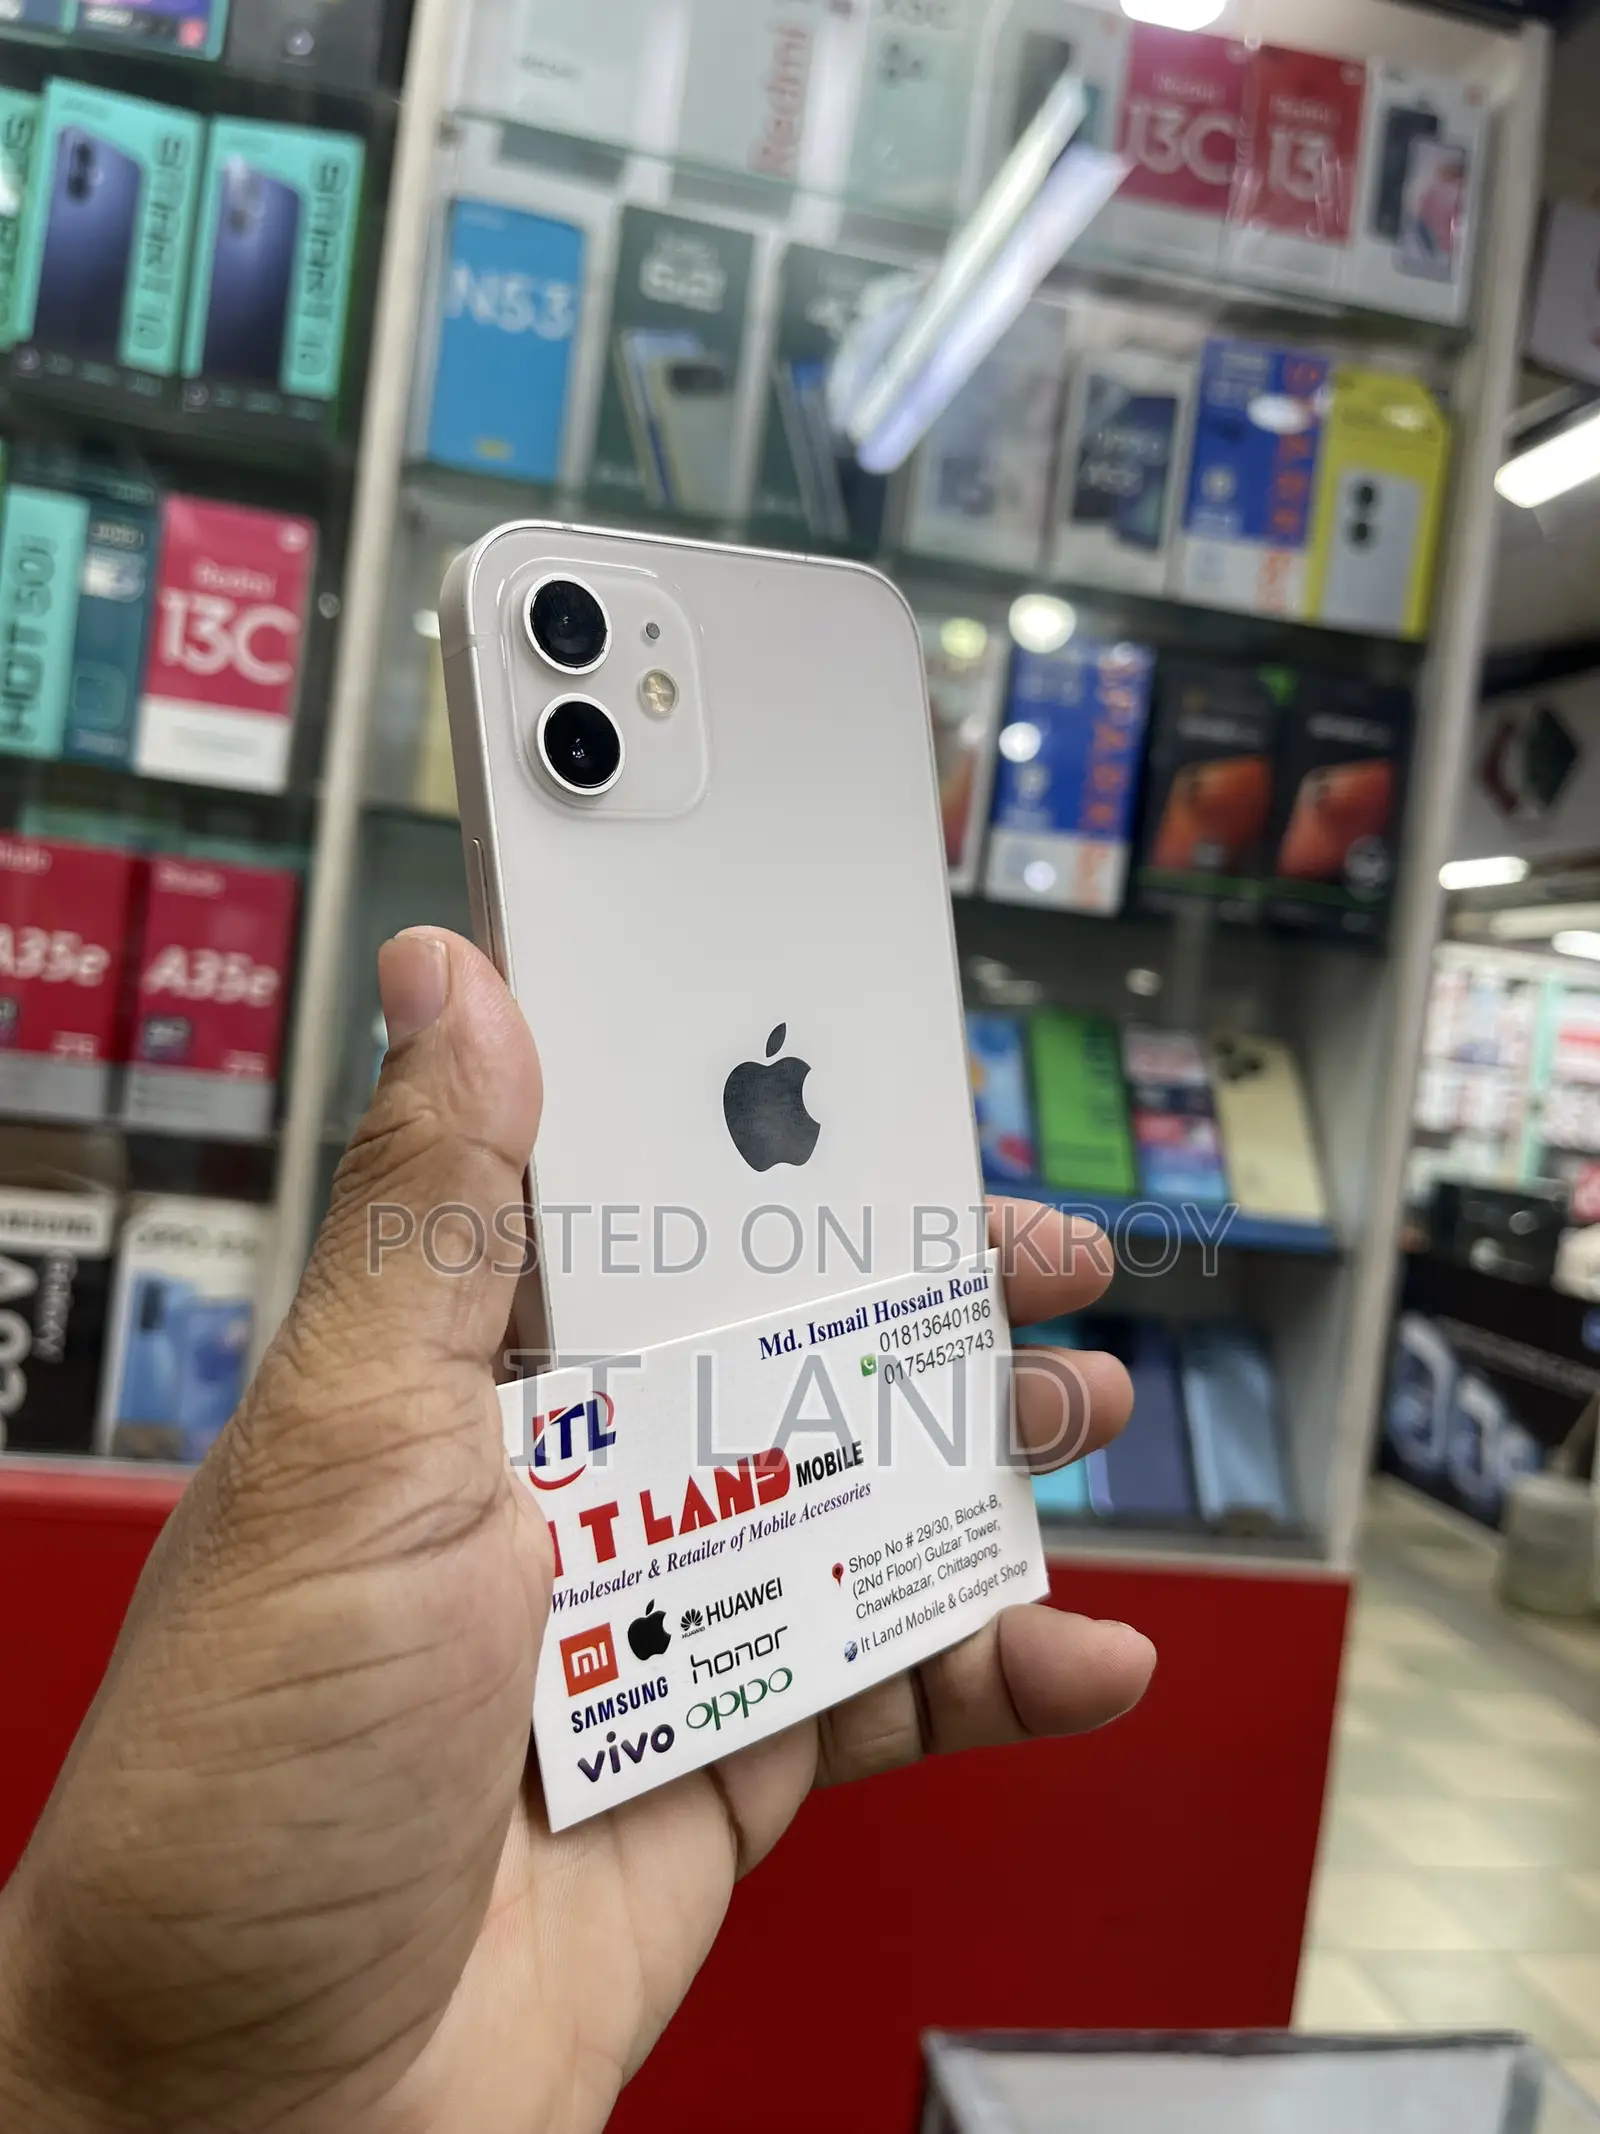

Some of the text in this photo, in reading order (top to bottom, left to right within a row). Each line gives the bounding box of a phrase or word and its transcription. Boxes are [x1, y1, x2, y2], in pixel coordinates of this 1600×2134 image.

[1126, 99, 1238, 187] 13C
[159, 587, 300, 685] 13C
[1, 620, 48, 742] HOT
[758, 1270, 990, 1360] Md. Ismail Hossain Roni
[879, 1298, 991, 1352] 01813640186
[884, 1329, 995, 1385] 01754523743
[639, 1447, 791, 1546] LAND
[795, 1440, 865, 1488] MOBILE
[551, 1482, 872, 1614] Wholesaler & Retailer of Mobile Accessories
[849, 1494, 1002, 1574] Shop No # 29/30, Block-B,
[852, 1518, 1001, 1600] (2Nd Floor) Gulzar Tower,
[705, 1577, 784, 1626] HUAWEI
[855, 1541, 1002, 1620] Chawkbazar, Chittagong.
[860, 1559, 1028, 1653] It Land Mobile & Gadget Shop
[690, 1625, 788, 1684] honor
[571, 1676, 669, 1733] SAMSUNG
[686, 1667, 793, 1731] oppo
[577, 1723, 675, 1783] vivo
